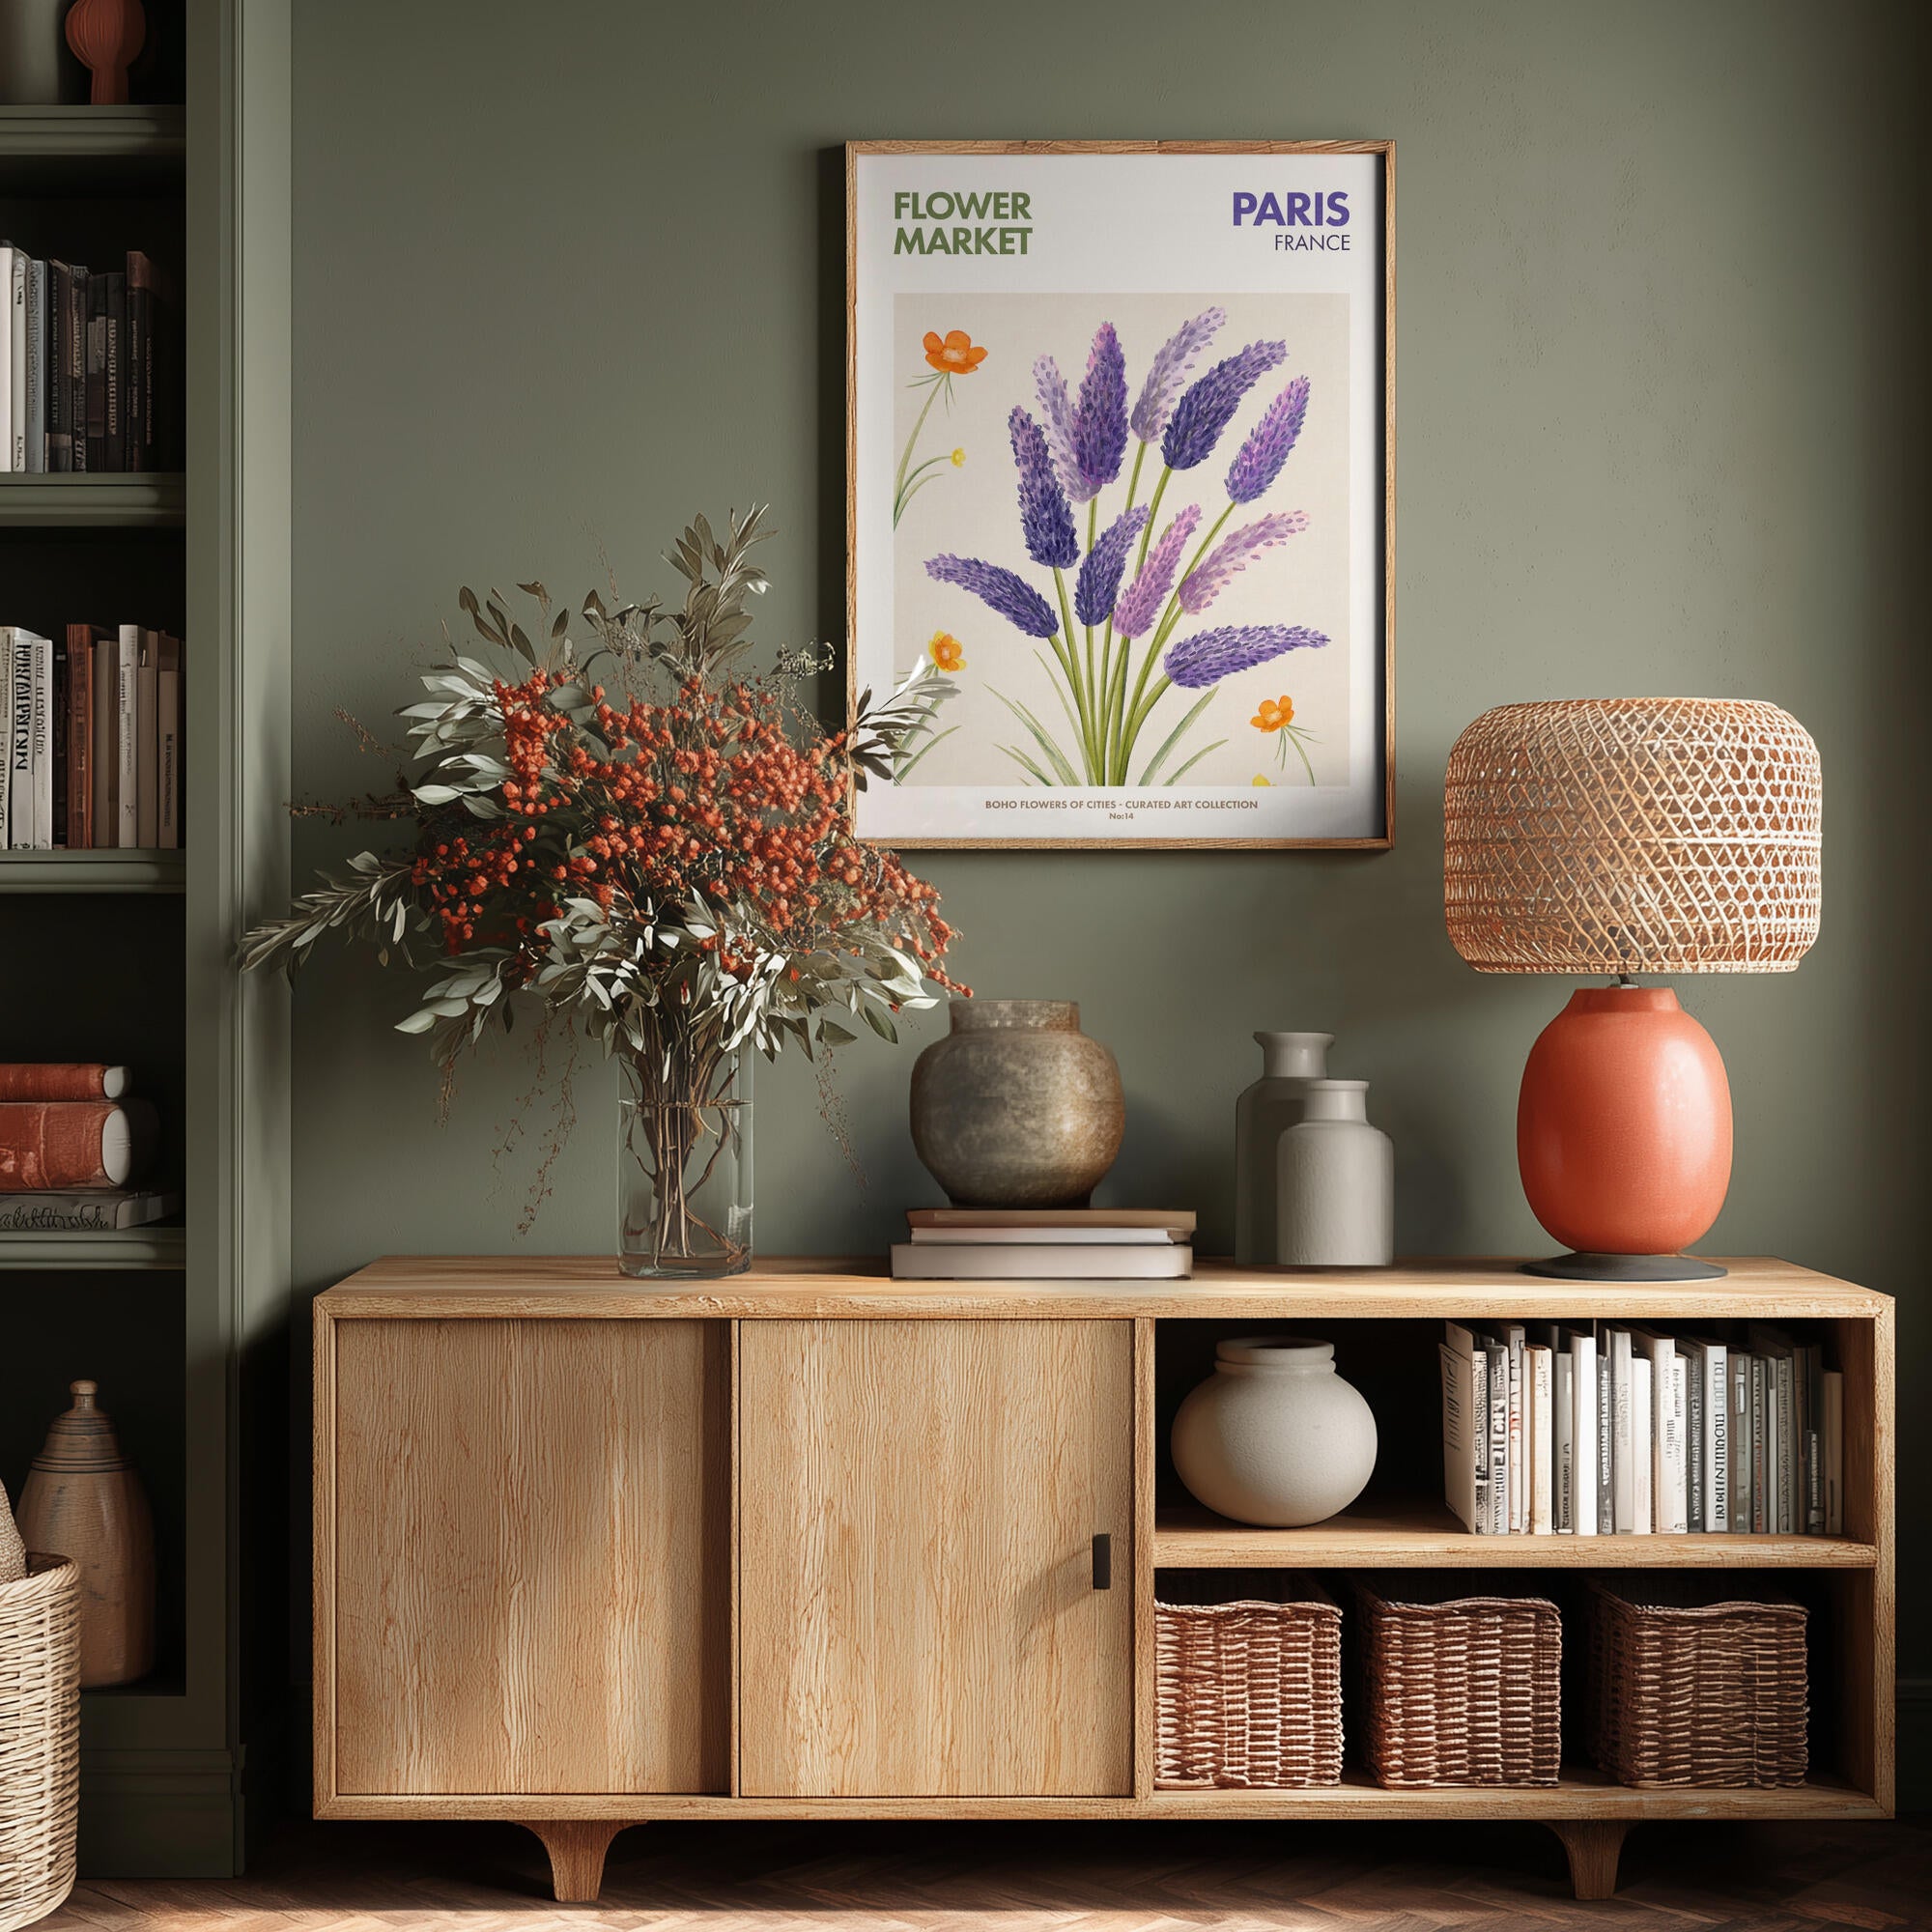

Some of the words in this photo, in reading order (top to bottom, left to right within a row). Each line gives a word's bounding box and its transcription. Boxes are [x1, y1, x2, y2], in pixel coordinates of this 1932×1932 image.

[894, 191, 1033, 220] FLOWER
[1233, 191, 1350, 227] PARIS
[893, 227, 1034, 255] MARKET
[1274, 234, 1351, 251] FRANCE
[985, 800, 1017, 810] BOHO
[1020, 800, 1067, 810] FLOWERS
[1069, 800, 1084, 810] OF
[1087, 800, 1117, 810] CITIES
[1124, 800, 1172, 810] CURATED
[1174, 800, 1193, 810] ART
[1195, 800, 1259, 810] COLLECTION
[1108, 811, 1134, 820] No:14
